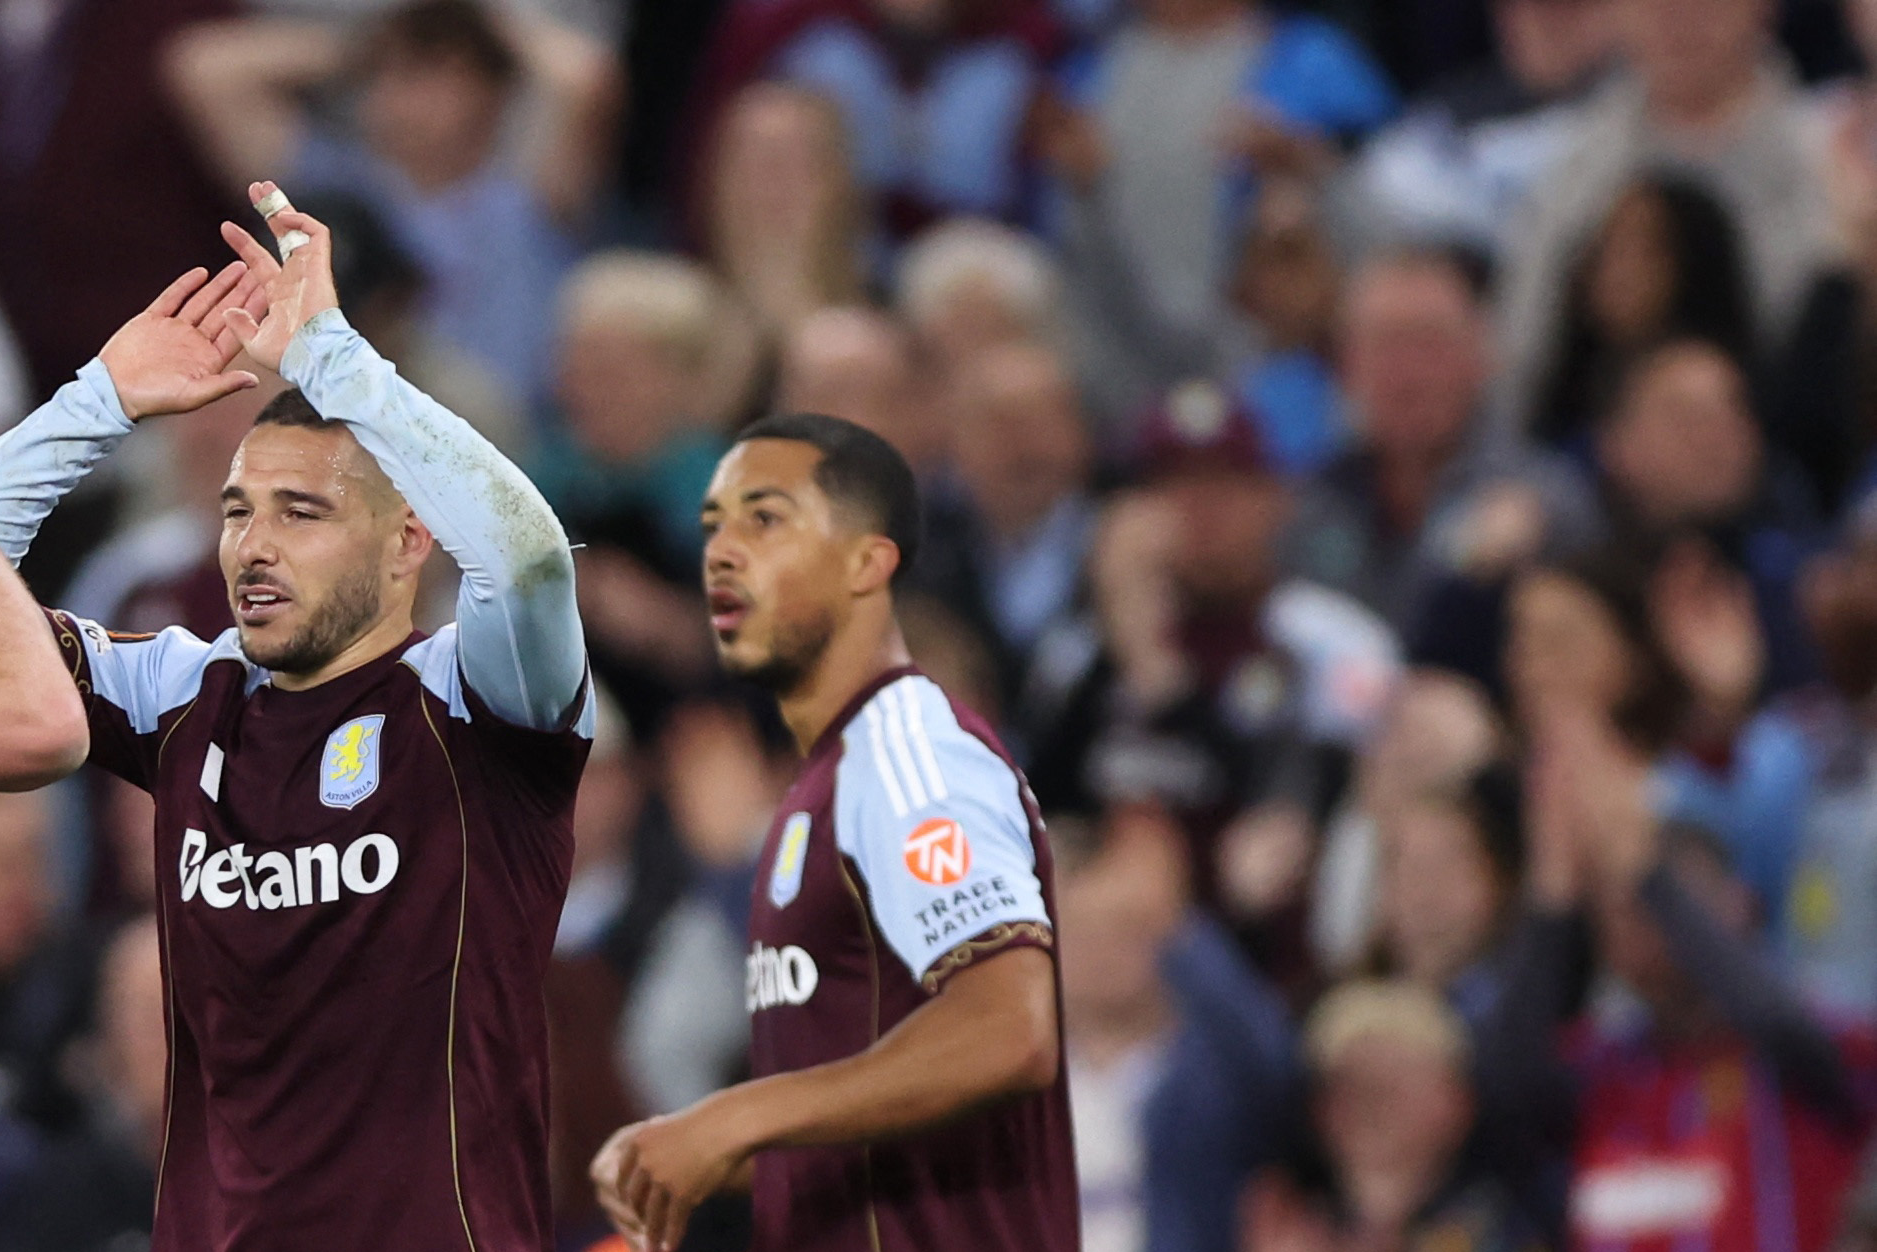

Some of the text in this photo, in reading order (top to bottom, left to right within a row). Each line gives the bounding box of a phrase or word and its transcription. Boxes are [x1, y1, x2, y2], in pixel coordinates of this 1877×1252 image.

[326, 780, 373, 801] ASTON VILLA
[179, 828, 400, 910] Betano
[915, 876, 1006, 926] TRADE
[924, 894, 1017, 946] NATION
